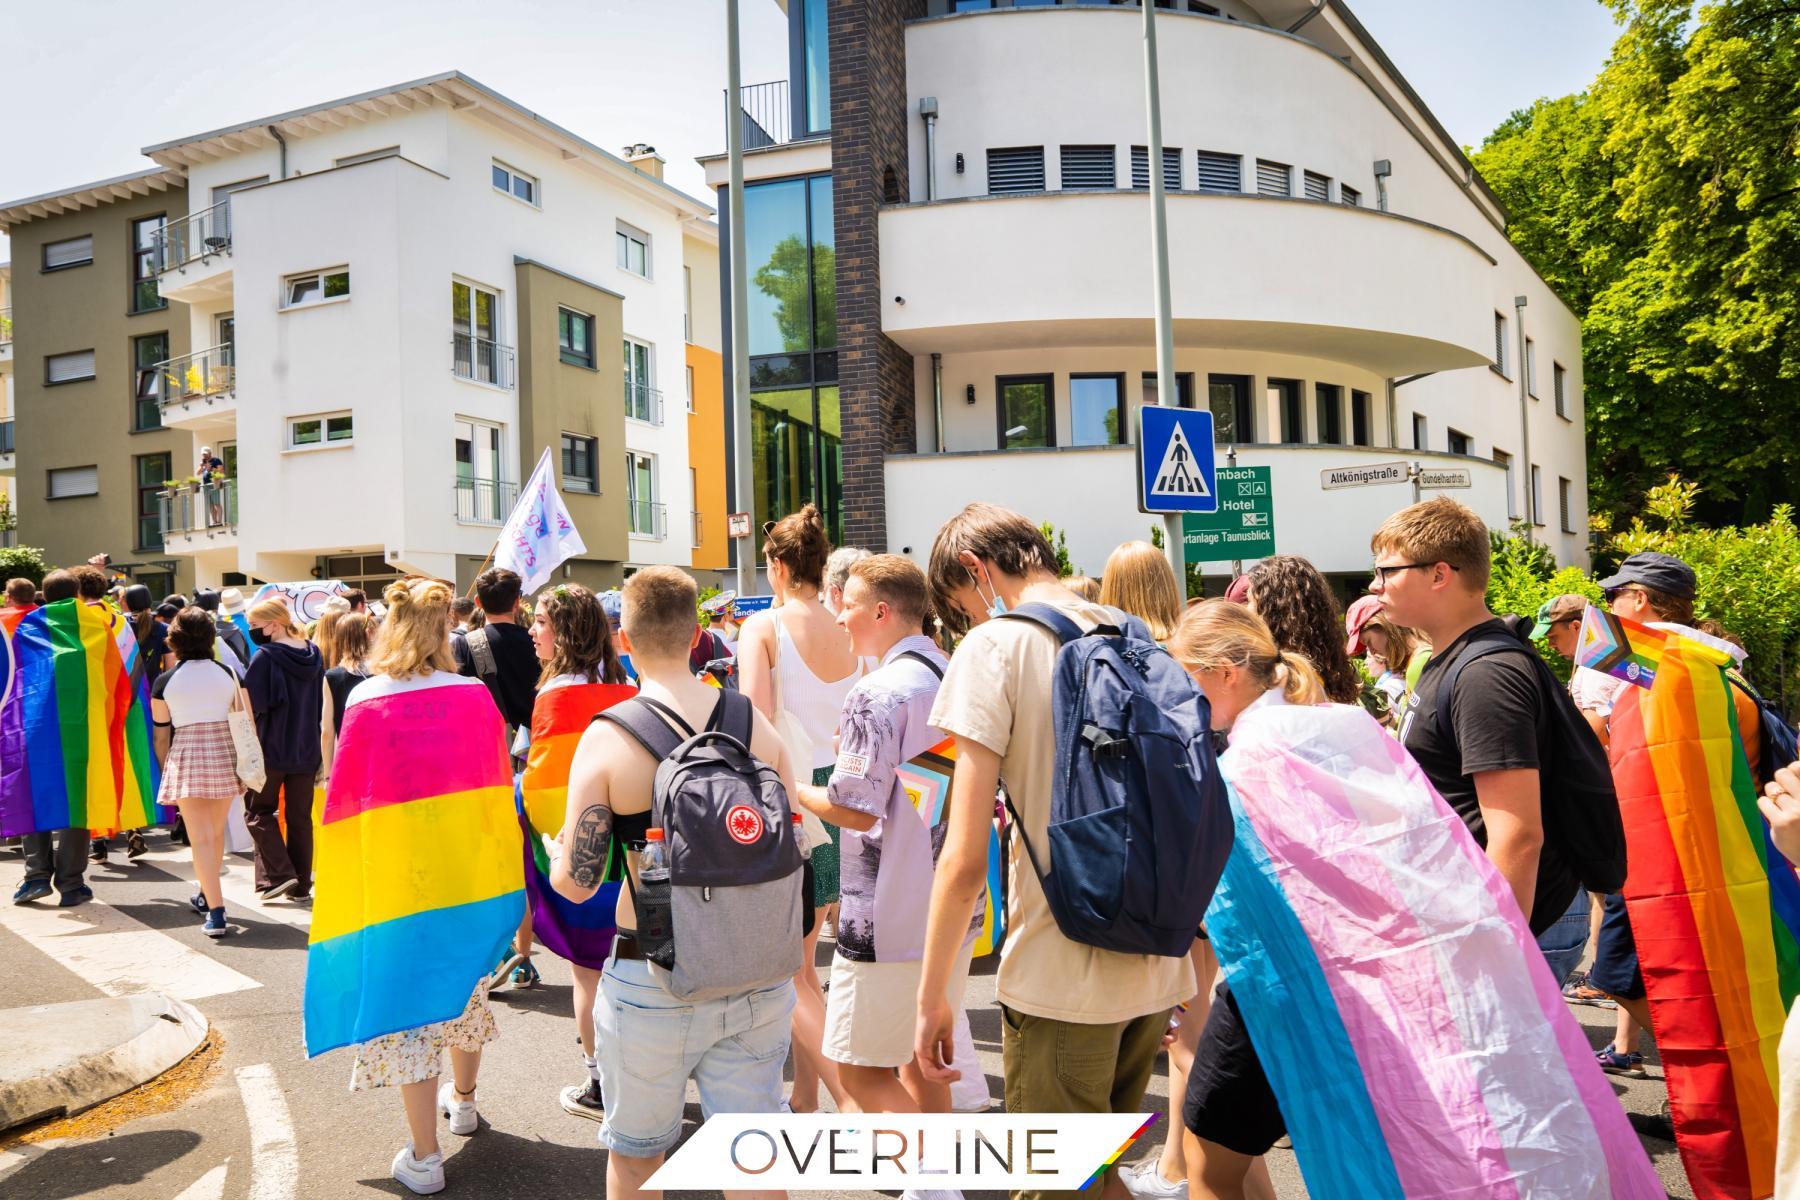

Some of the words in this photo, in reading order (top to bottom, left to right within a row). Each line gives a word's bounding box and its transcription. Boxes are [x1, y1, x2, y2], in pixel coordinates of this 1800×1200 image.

[1216, 468, 1256, 480] mbach
[1330, 467, 1399, 484] Altkönigstraße
[1223, 500, 1254, 511] Hotel
[1221, 530, 1271, 542] Taunusblick
